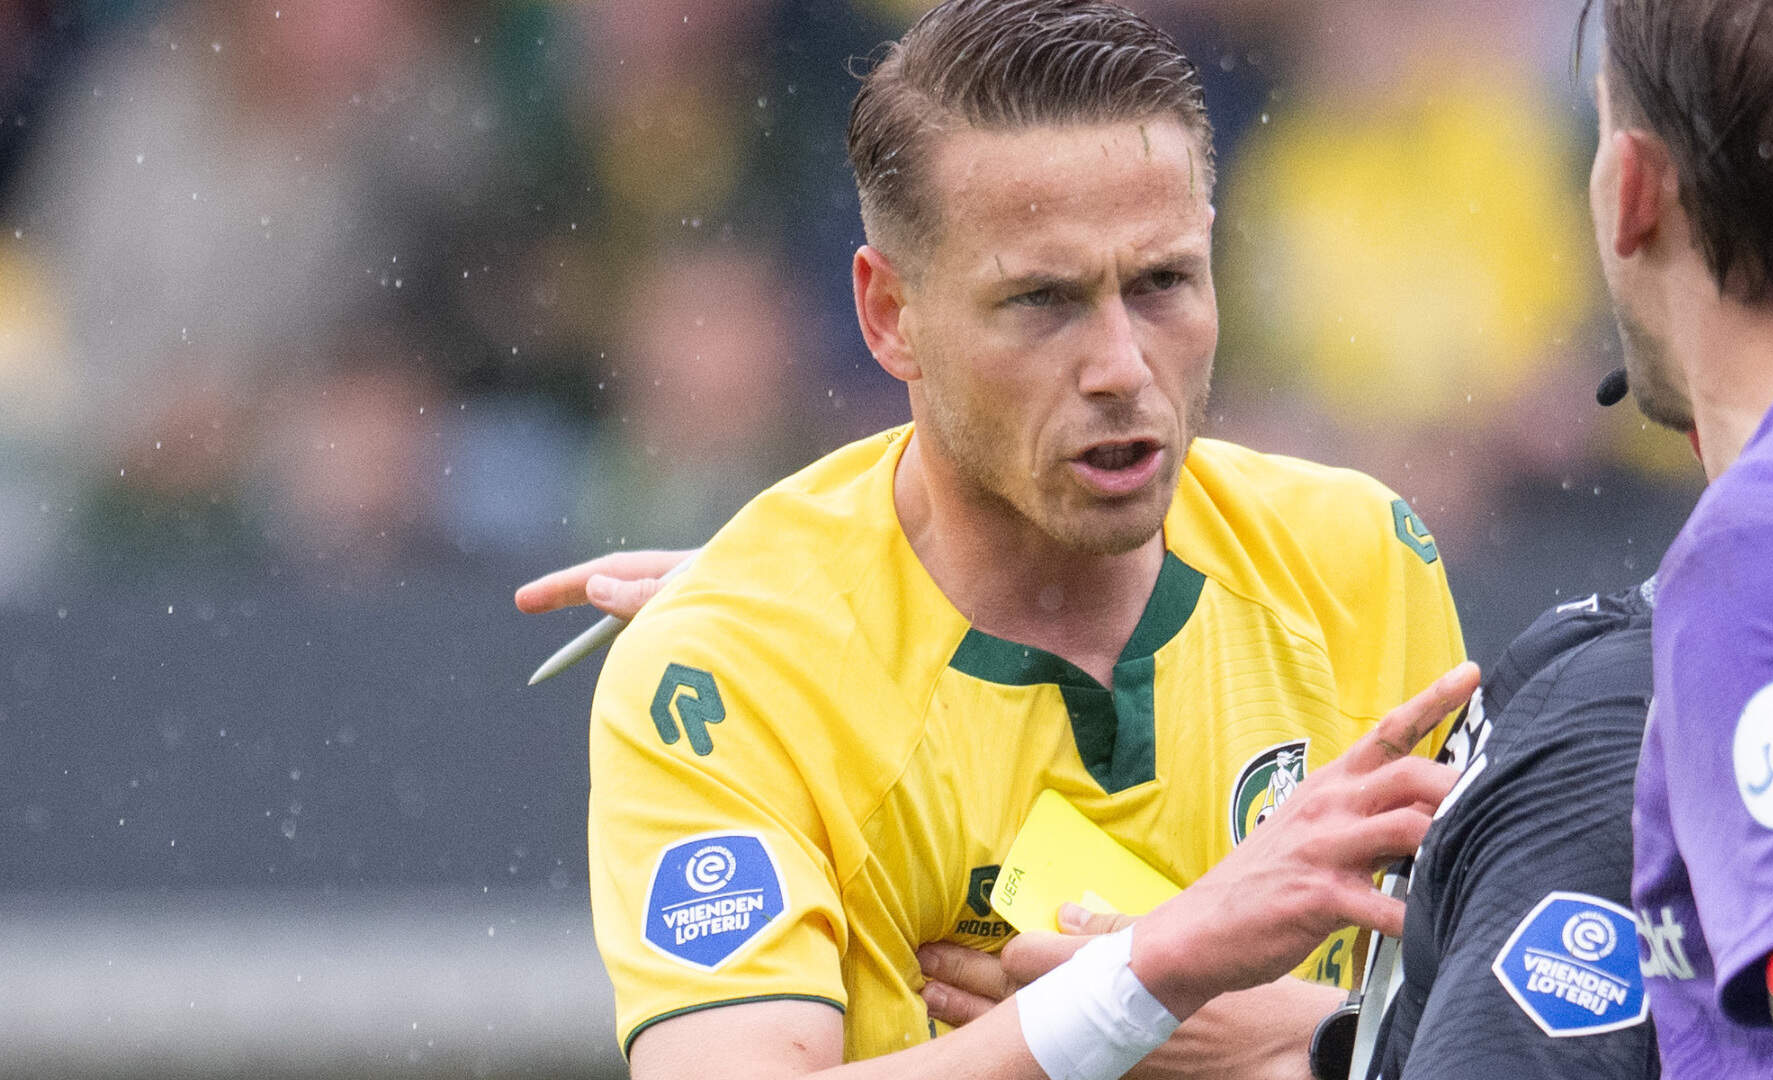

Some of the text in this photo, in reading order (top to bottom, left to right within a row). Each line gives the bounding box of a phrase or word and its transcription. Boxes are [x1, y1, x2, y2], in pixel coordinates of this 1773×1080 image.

[1000, 867, 1025, 906] UEFA
[662, 895, 764, 929] VRIENDEN
[675, 912, 750, 945] LOTERIJ
[1523, 953, 1628, 1006] VRIENDEN
[1526, 972, 1610, 1016] LOTERIJ
